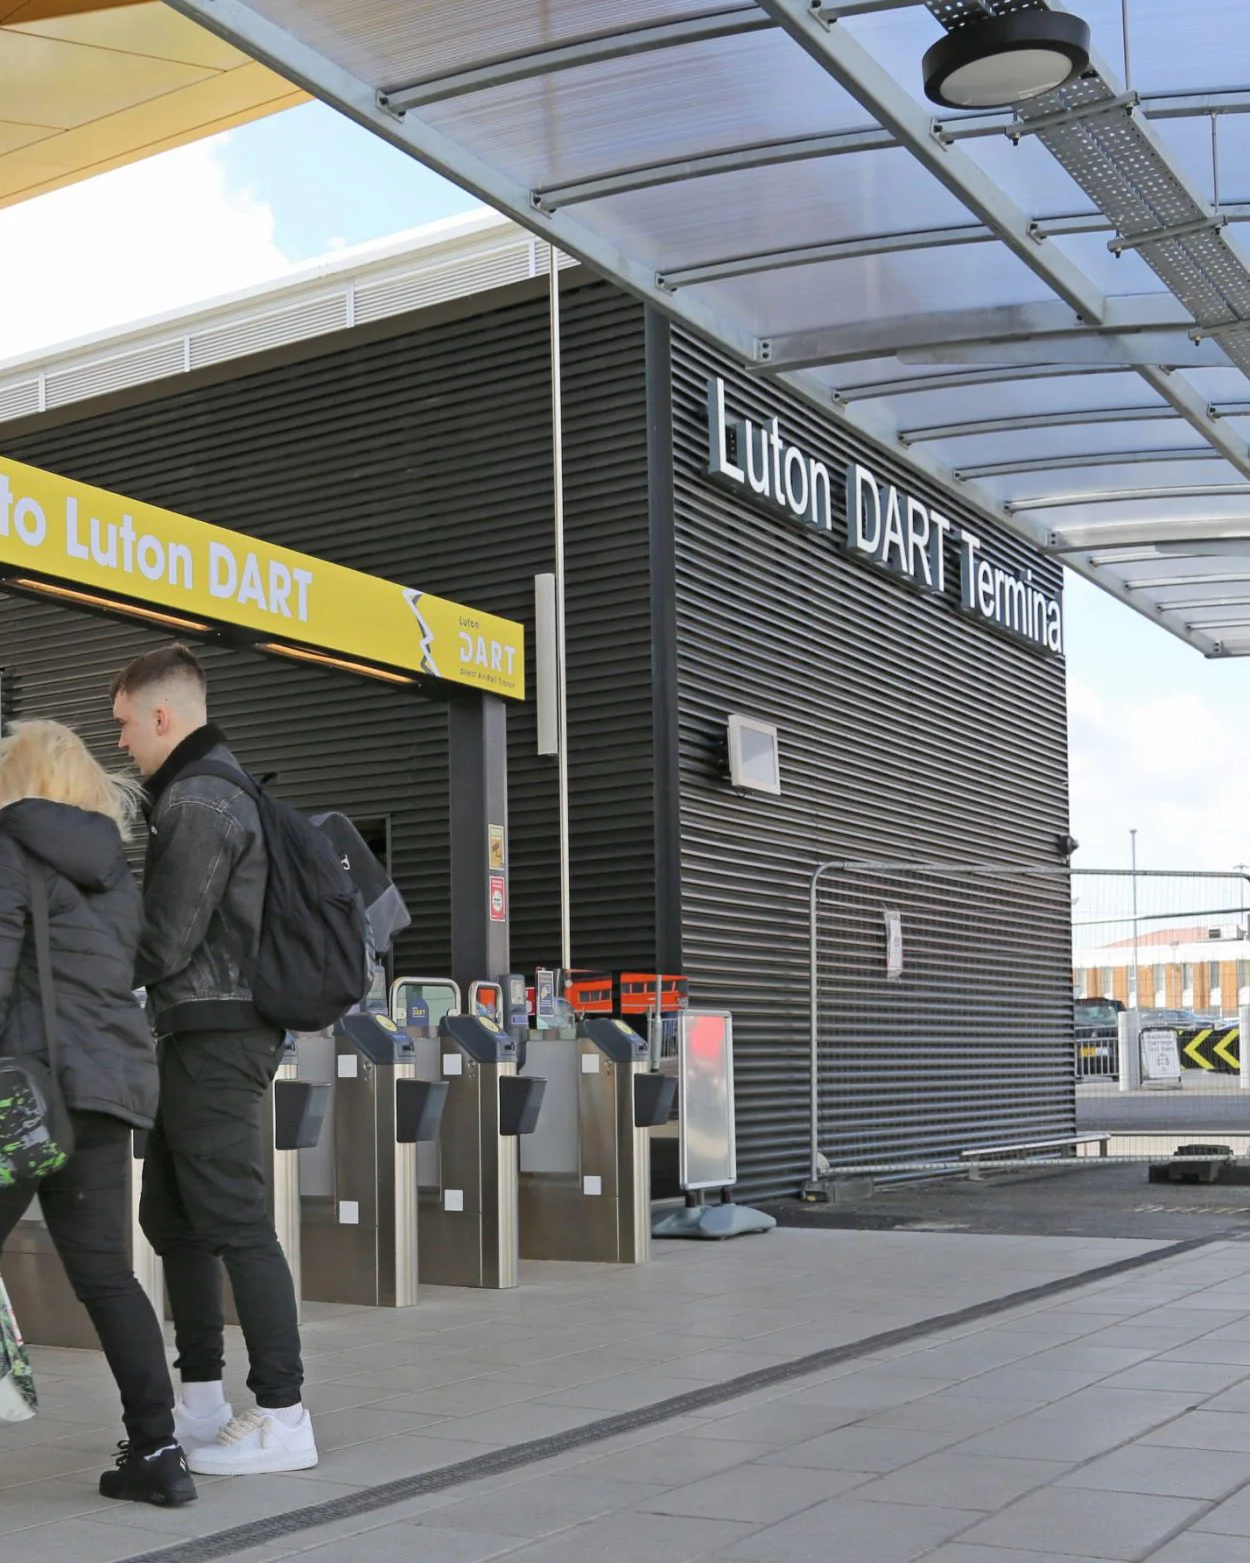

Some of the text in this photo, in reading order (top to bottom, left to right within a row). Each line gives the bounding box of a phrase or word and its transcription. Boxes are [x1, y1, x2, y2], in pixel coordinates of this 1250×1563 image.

[713, 377, 832, 532] Luton
[851, 463, 950, 593] DART
[66, 497, 193, 589] Luton
[209, 541, 313, 622] DART
[458, 630, 516, 676] DART
[459, 616, 480, 629] Luton
